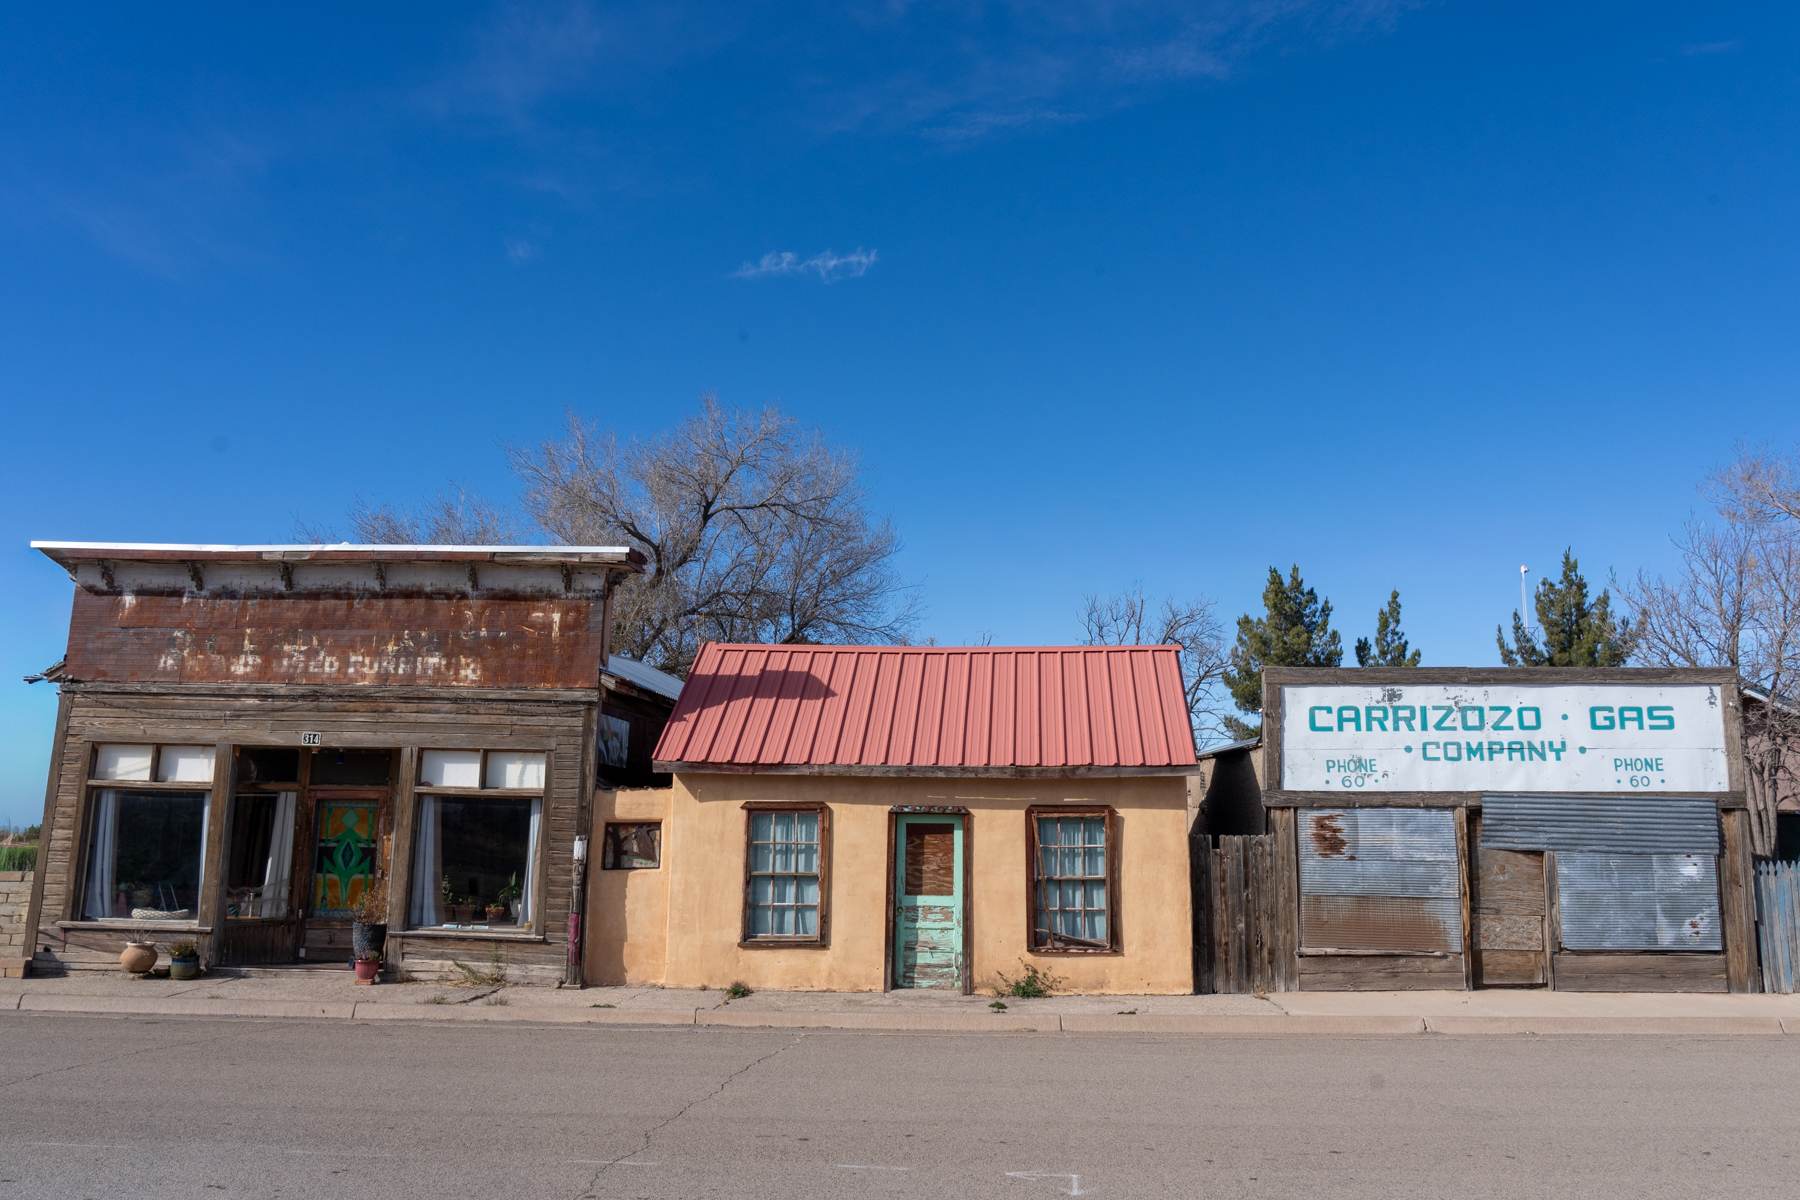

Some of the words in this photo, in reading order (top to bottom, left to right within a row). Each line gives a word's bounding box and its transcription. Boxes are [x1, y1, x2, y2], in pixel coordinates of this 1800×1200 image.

[1308, 705, 1542, 732] CARRIZOZO
[1589, 705, 1675, 730] GAS
[303, 734, 319, 744] 314
[1421, 740, 1567, 762] COMPANY
[1325, 758, 1378, 773] PHONE
[1613, 757, 1664, 772] PHONE
[1341, 775, 1365, 788] 60
[1629, 775, 1651, 788] 60
